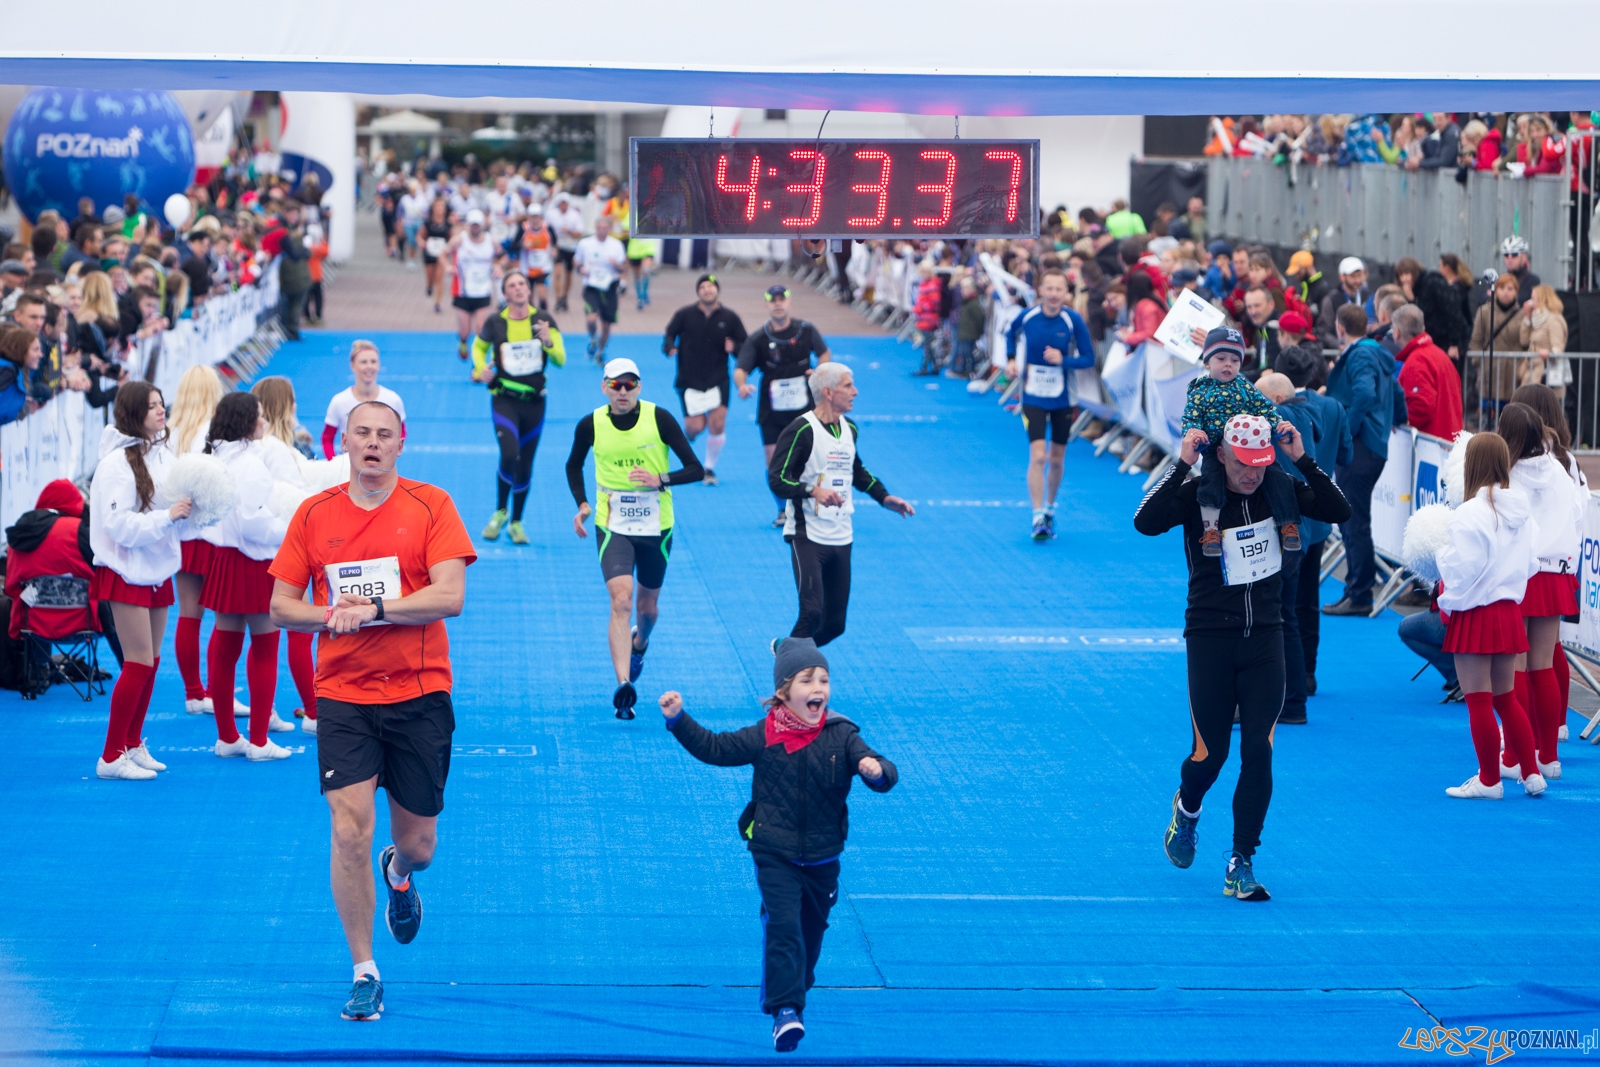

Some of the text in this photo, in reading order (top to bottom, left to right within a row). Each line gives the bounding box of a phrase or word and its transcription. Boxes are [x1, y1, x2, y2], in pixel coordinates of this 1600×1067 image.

[716, 150, 1022, 226] 4:33.37
[620, 507, 651, 517] 5856
[1240, 539, 1269, 558] 1397
[1250, 557, 1266, 566] Janusz
[1584, 538, 1600, 577] PO
[340, 581, 385, 596] 5083
